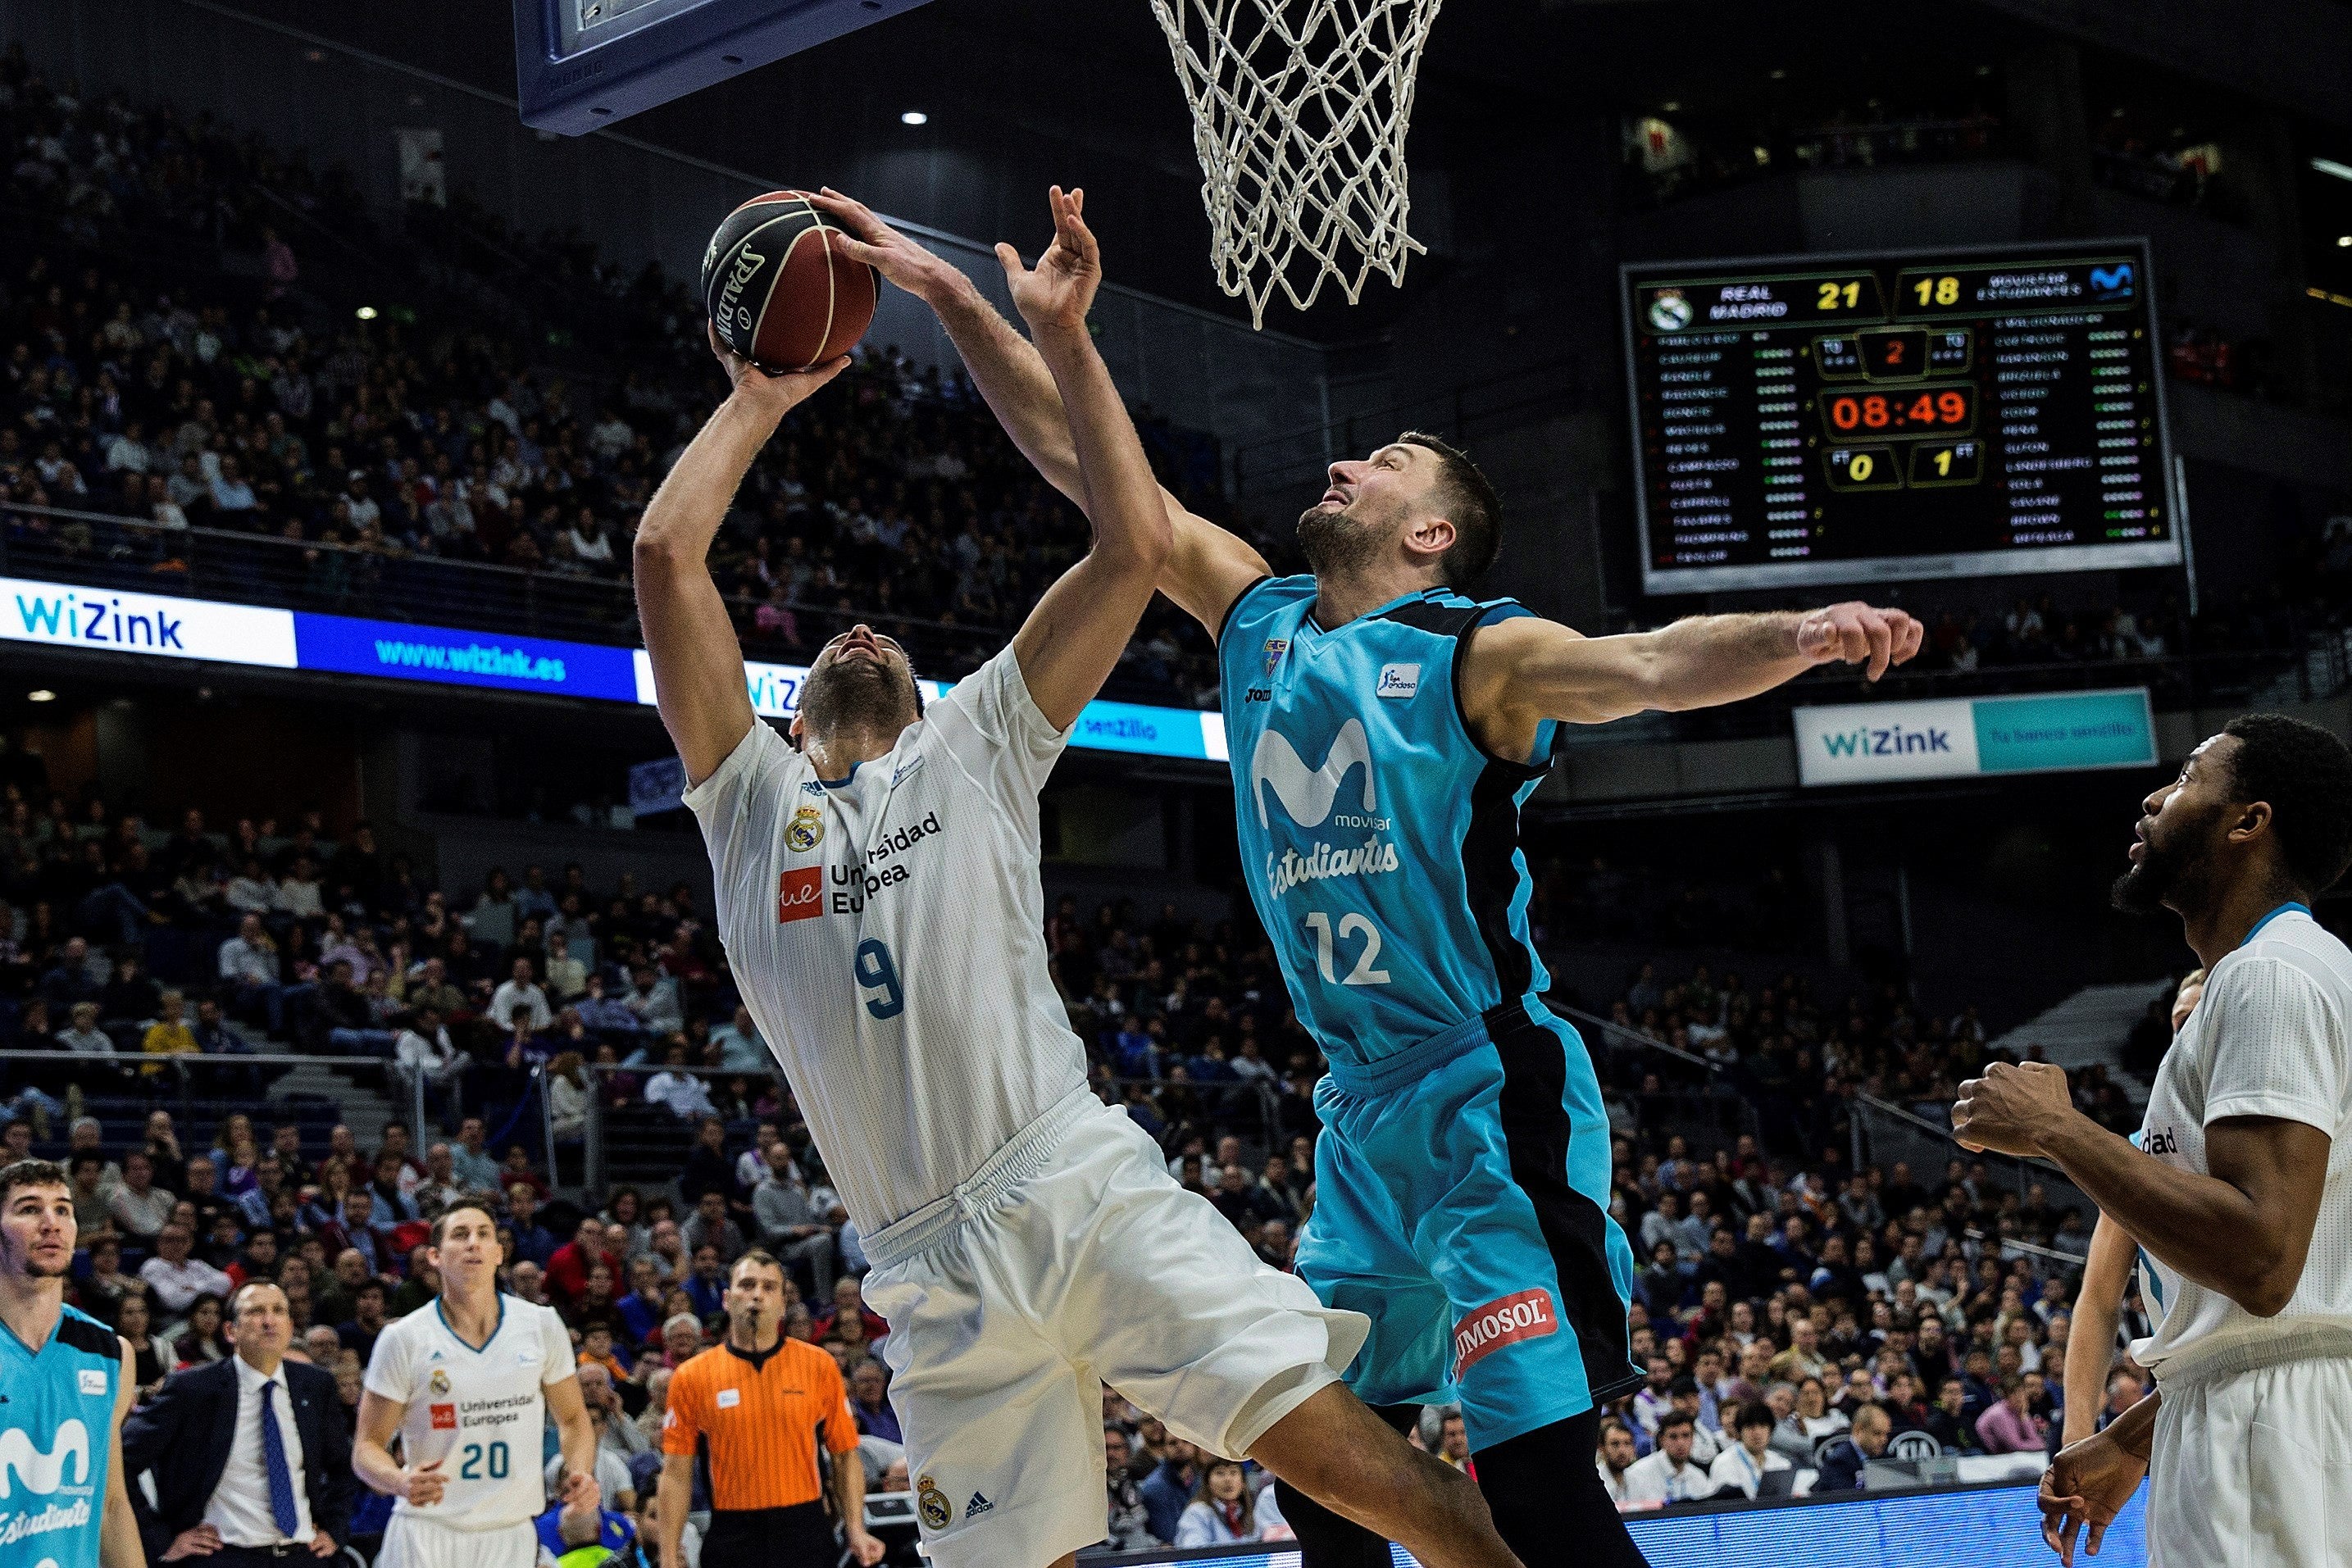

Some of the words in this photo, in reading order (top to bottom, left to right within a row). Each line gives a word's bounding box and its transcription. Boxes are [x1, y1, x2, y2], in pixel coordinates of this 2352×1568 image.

[717, 243, 765, 348] SPALDIN
[1720, 286, 1773, 302] REAL
[1817, 281, 1861, 310] 21
[1913, 276, 1960, 307] 18
[1709, 300, 1788, 320] MADRID
[1886, 340, 1905, 365] 2
[1831, 391, 1966, 430] 08:49
[1849, 454, 1873, 482] 0
[1933, 450, 1953, 477] 1
[16, 593, 184, 650] WiZink
[375, 639, 566, 683] www.wizink.es
[1822, 726, 1951, 760] WiZink
[1305, 911, 1392, 986] 12
[853, 937, 904, 1020] 9
[1456, 1298, 1547, 1361] UMOSOL
[461, 1441, 510, 1480] 20
[965, 1502, 994, 1519] adidas
